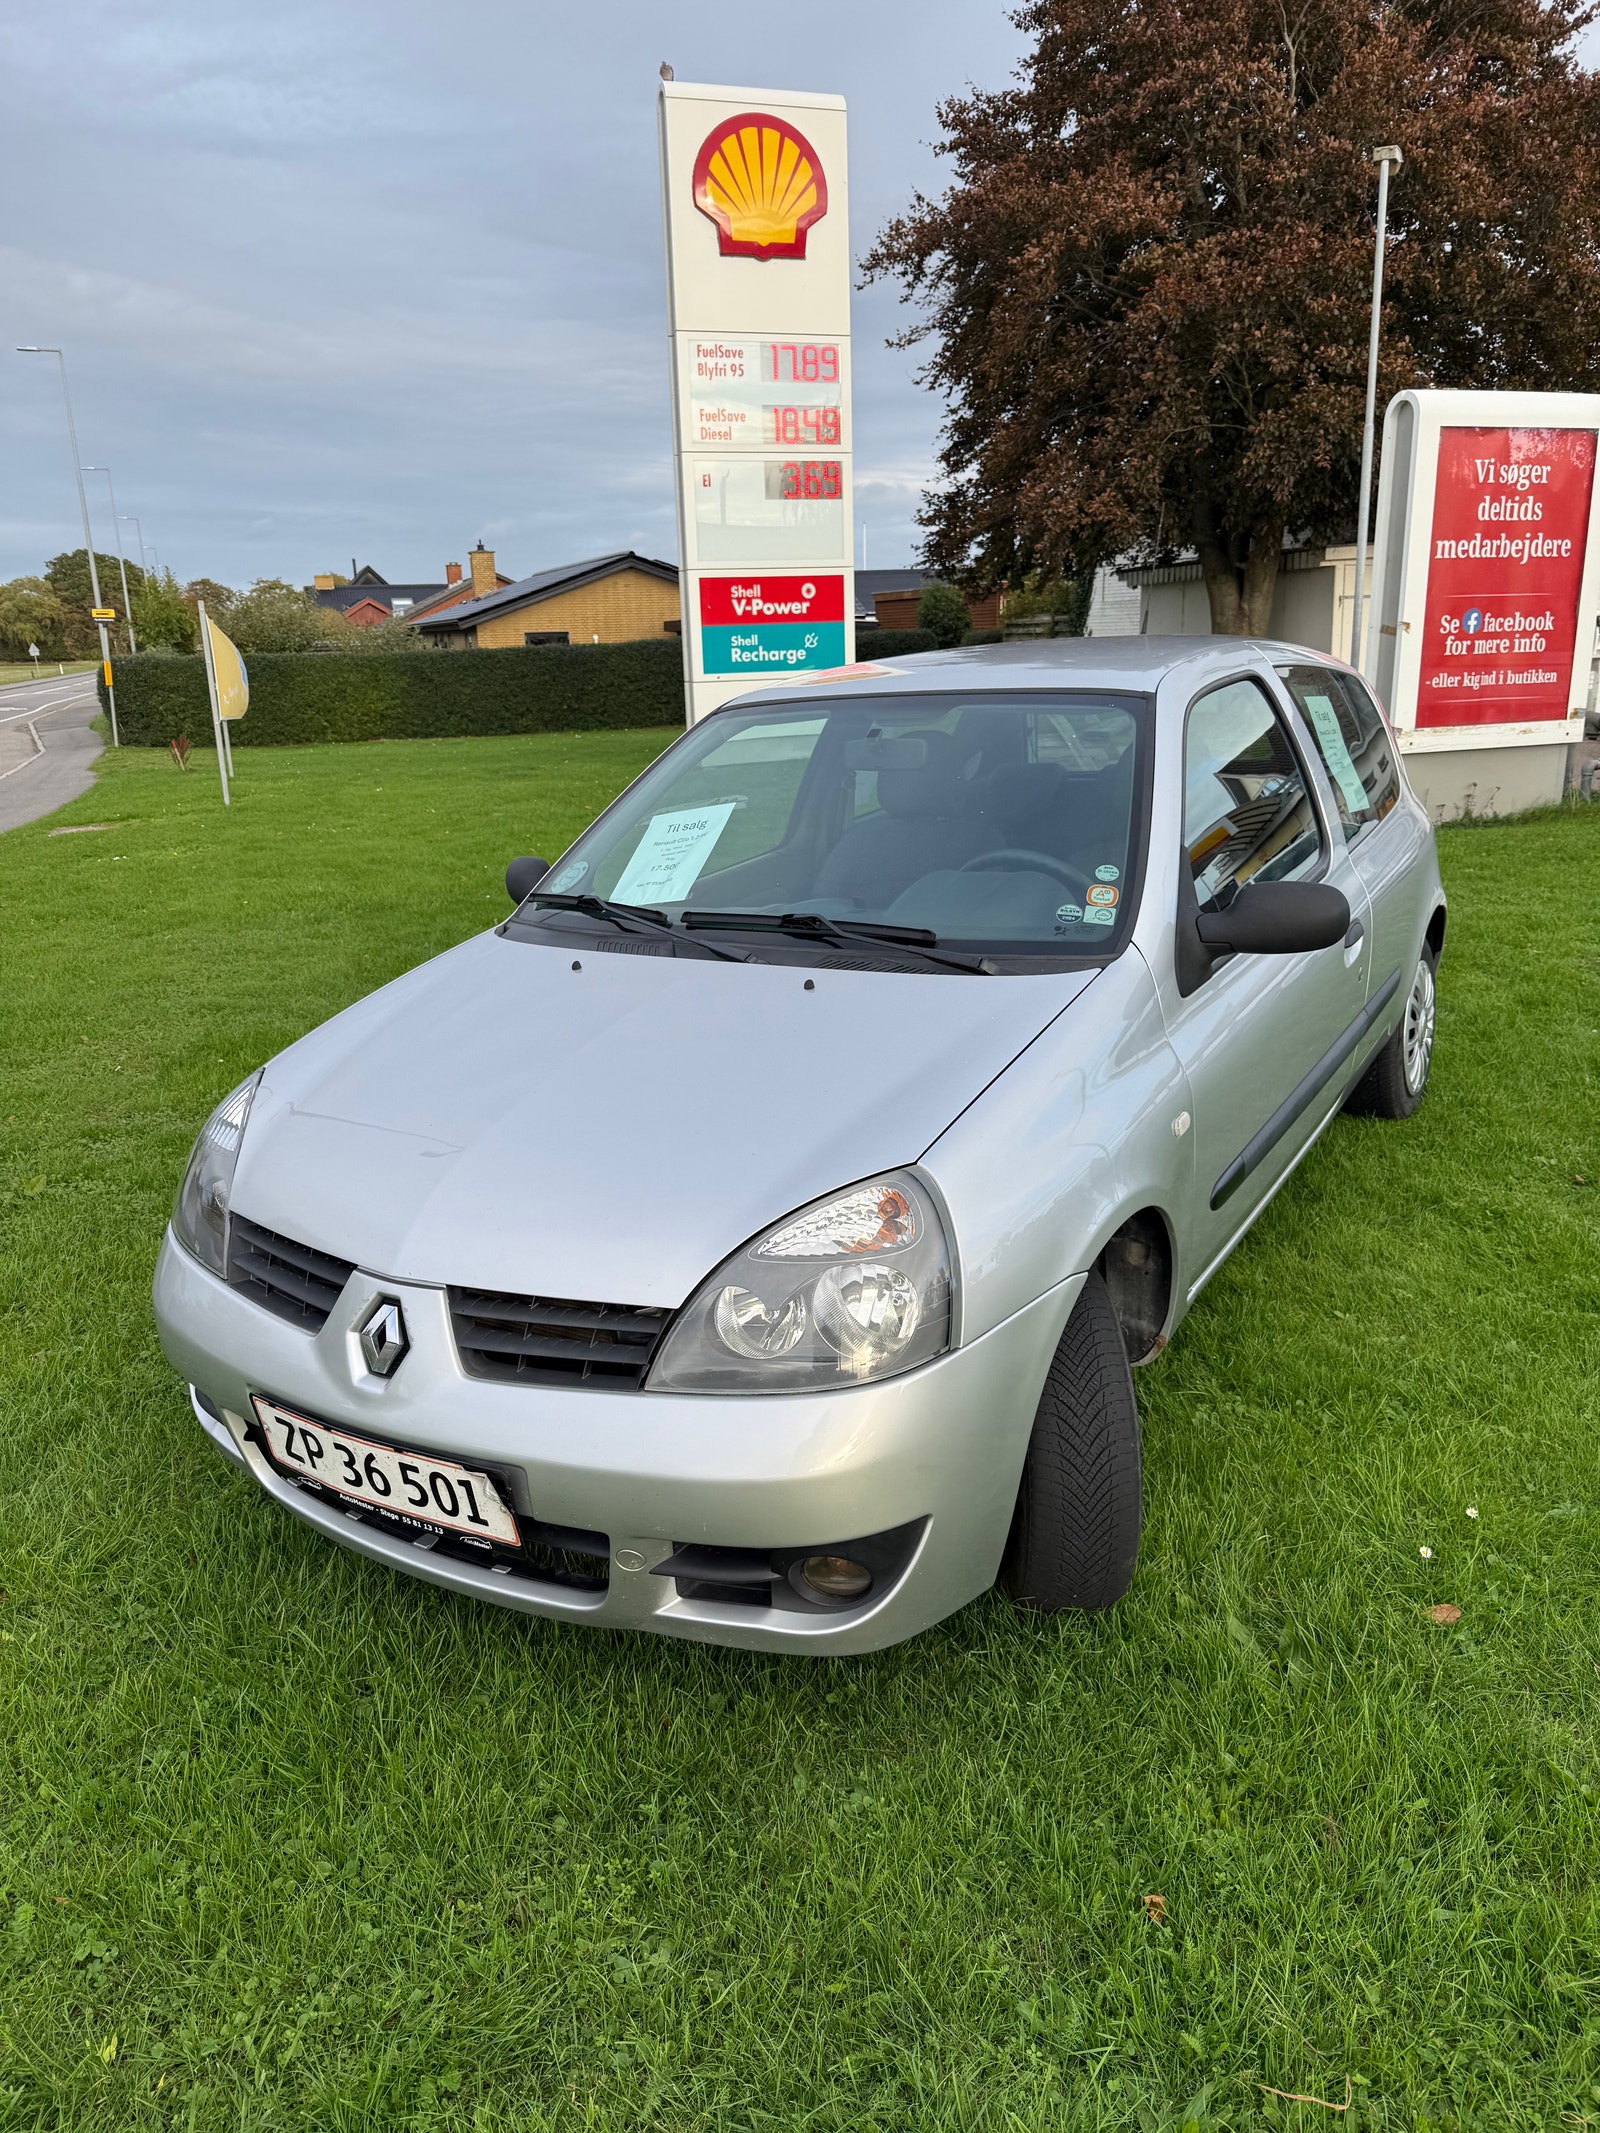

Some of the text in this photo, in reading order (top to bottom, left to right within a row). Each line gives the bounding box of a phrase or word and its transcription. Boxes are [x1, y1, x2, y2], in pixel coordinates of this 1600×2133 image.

[696, 344, 744, 358] FuelSave
[697, 363, 744, 381] Blyfri 95
[770, 344, 839, 382] 17.89
[699, 408, 746, 422] FuelSave
[700, 427, 732, 440] Diesel
[773, 407, 840, 444] 18.49
[702, 473, 712, 487] El
[783, 462, 841, 499] 3.69
[1474, 458, 1551, 491] Vi søger
[1477, 496, 1543, 522] deltids
[1434, 532, 1571, 564] medarbejdere
[730, 584, 761, 598] Shell
[731, 599, 810, 616] V-Power
[1440, 615, 1460, 634] Se
[1483, 611, 1554, 632] facebook
[731, 634, 758, 646] Shell
[1444, 633, 1546, 655] for mere info
[731, 646, 806, 664] Recharge
[1498, 671, 1504, 685] i
[1506, 669, 1557, 685] butikken
[667, 819, 709, 833] Til salg
[274, 1416, 489, 1527] ZP 36 501
[339, 1493, 374, 1511] AutoMester
[380, 1508, 399, 1521] Stege
[402, 1516, 411, 1525] 55
[423, 1523, 433, 1531] 13
[434, 1527, 444, 1535] 13
